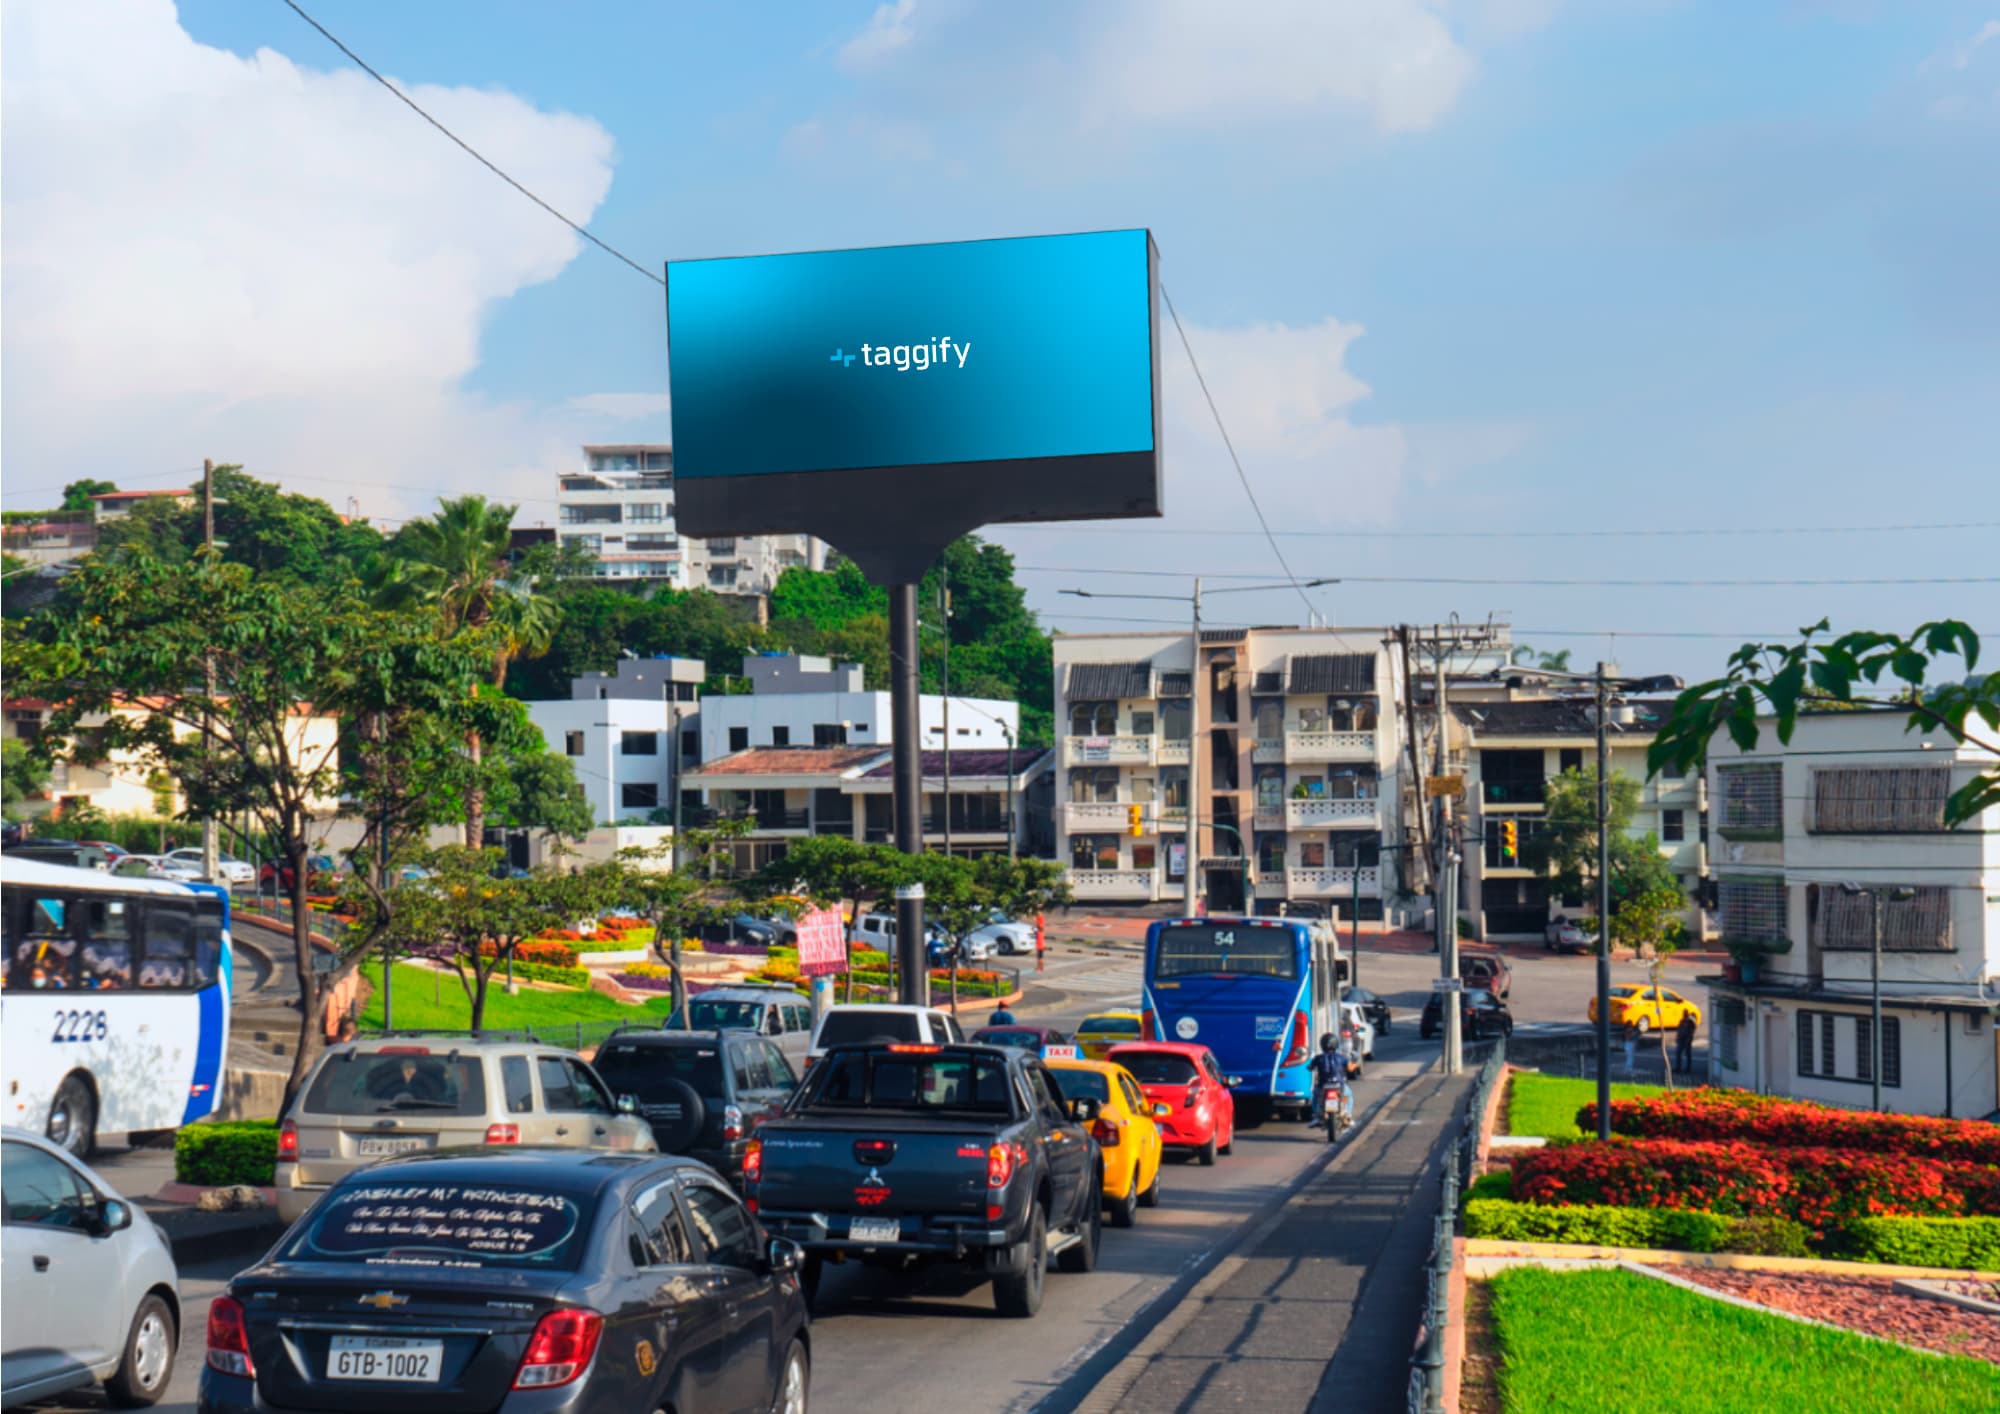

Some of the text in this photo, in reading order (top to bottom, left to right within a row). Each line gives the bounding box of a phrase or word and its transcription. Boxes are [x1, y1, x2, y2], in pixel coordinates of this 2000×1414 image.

[861, 336, 971, 371] taggify
[1214, 931, 1234, 946] 54
[1049, 1047, 1073, 1056] TAXI
[338, 1351, 429, 1377] GTB-1002
